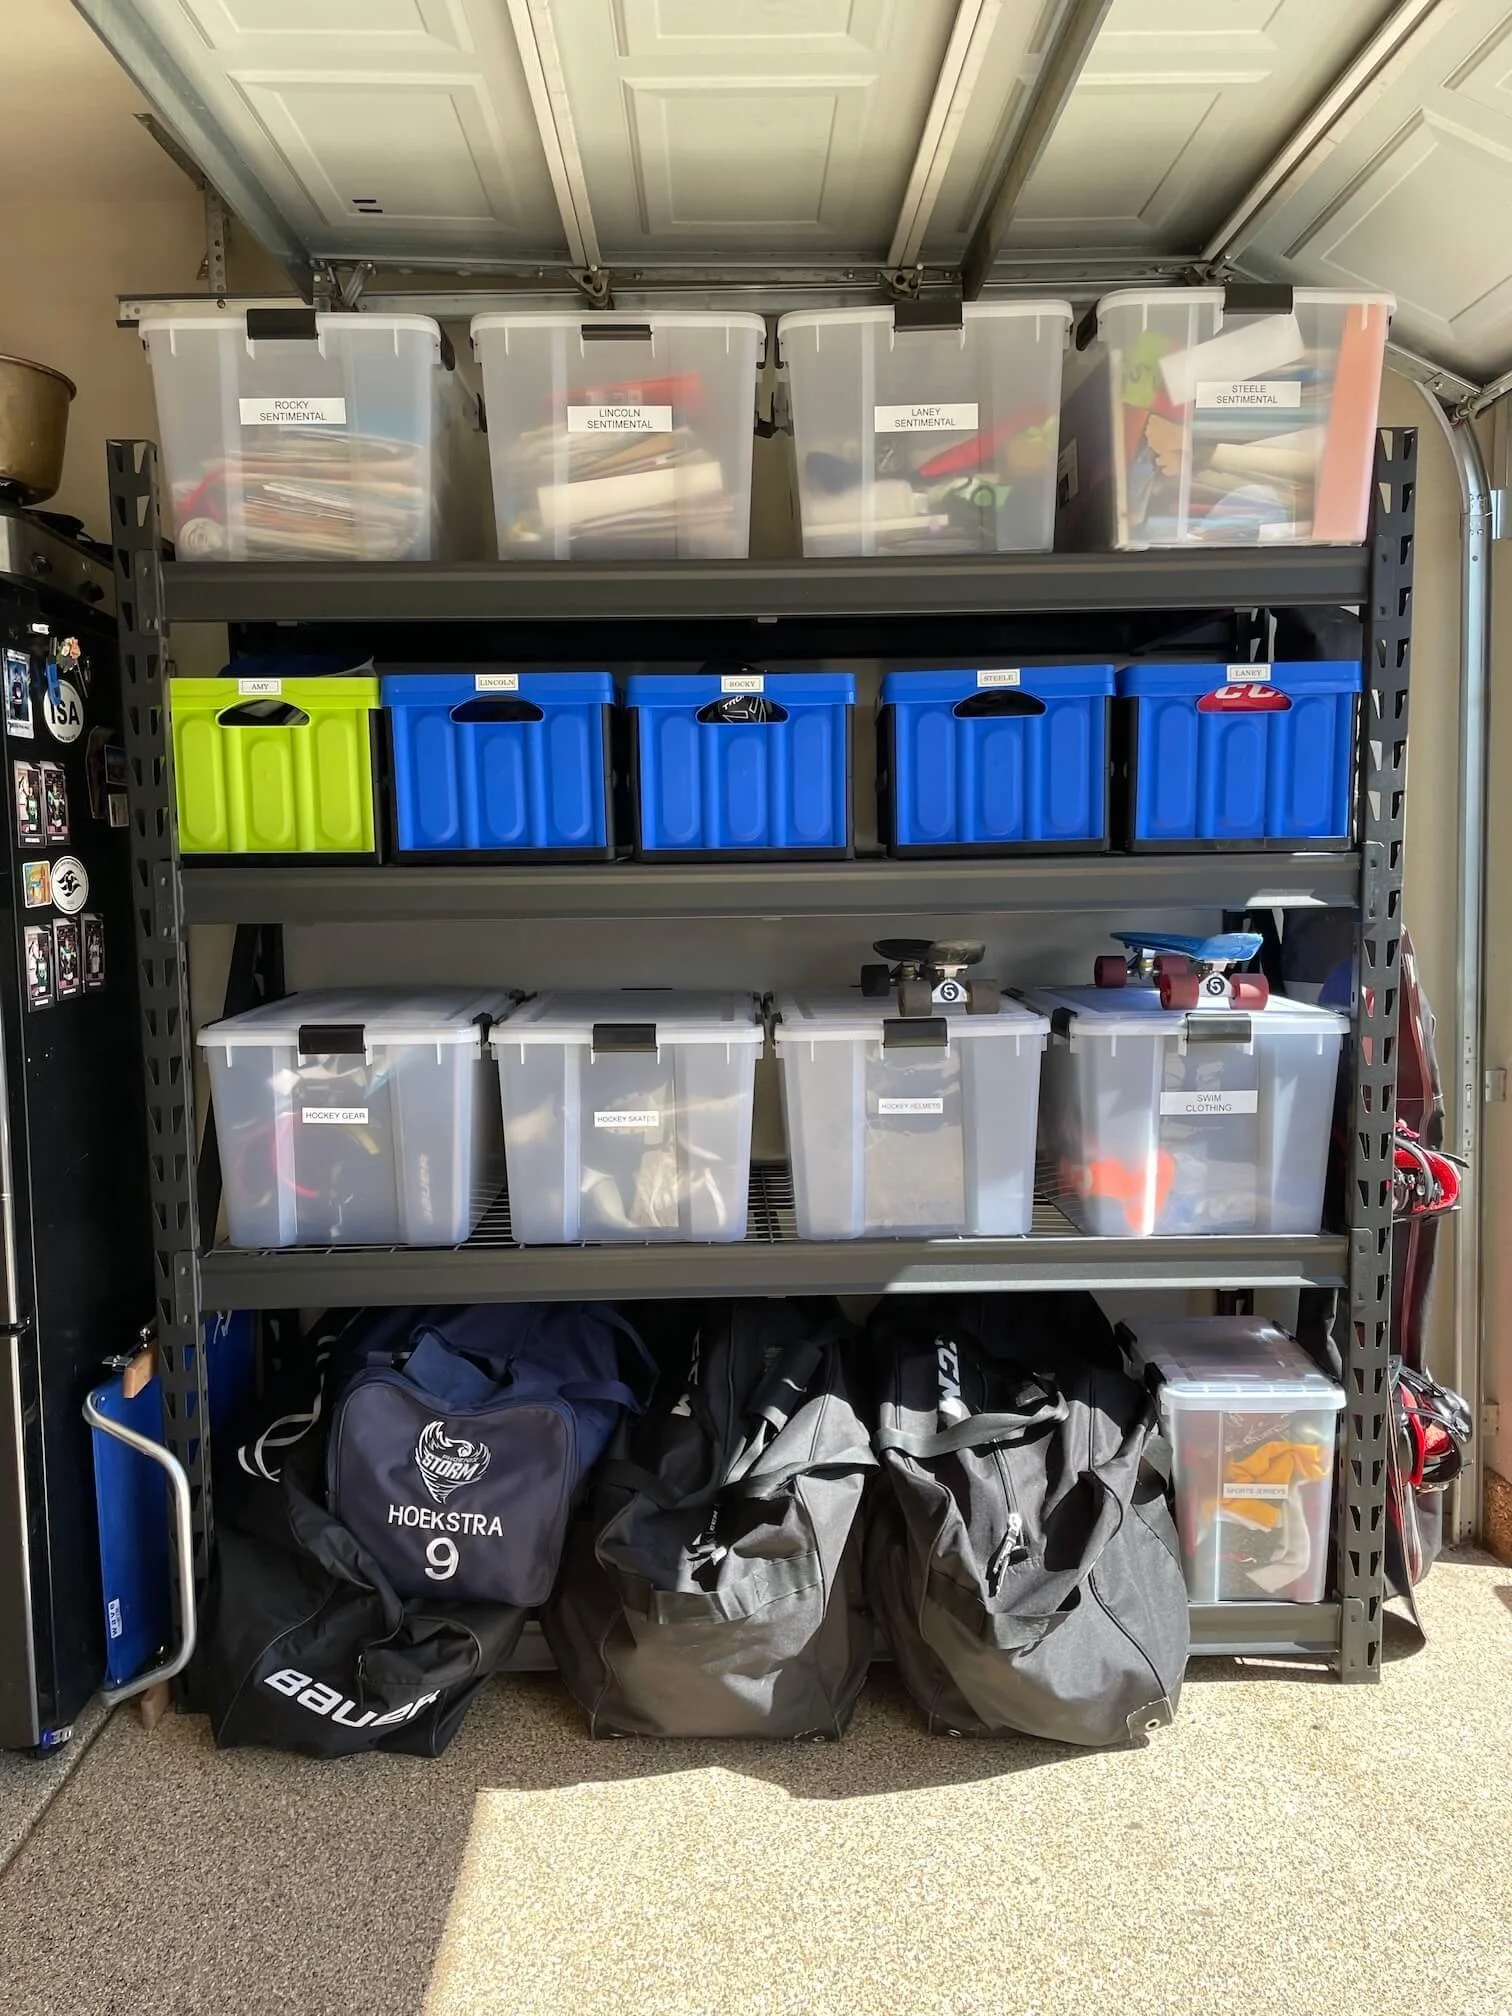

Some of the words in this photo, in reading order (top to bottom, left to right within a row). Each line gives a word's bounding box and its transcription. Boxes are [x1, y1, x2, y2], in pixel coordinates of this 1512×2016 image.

[1231, 384, 1267, 393] STEELE
[1216, 395, 1278, 404] SENTIMENTAL
[274, 400, 310, 410] ROCKY
[259, 411, 328, 421] SENTIMENTAL
[599, 408, 641, 418] LINCOLN
[911, 407, 942, 417] LANEY
[587, 420, 653, 429] SENTIMENTAL
[895, 418, 956, 428] SENTIMENTAL
[1235, 669, 1262, 677] LANEY
[251, 683, 270, 691] AMY
[480, 679, 515, 687] LINCOLN
[729, 680, 756, 688] ROCKY
[1196, 1094, 1222, 1102] SWIM
[1185, 1104, 1233, 1112] CLOTHING
[305, 1111, 340, 1119] HOCKEY
[341, 1112, 366, 1120] GEAR
[597, 1114, 627, 1123] HOCKEY
[628, 1114, 658, 1122] SKATES
[422, 1454, 480, 1480] STORM
[388, 1504, 503, 1536] HOEKSTRA
[424, 1537, 459, 1580] 9
